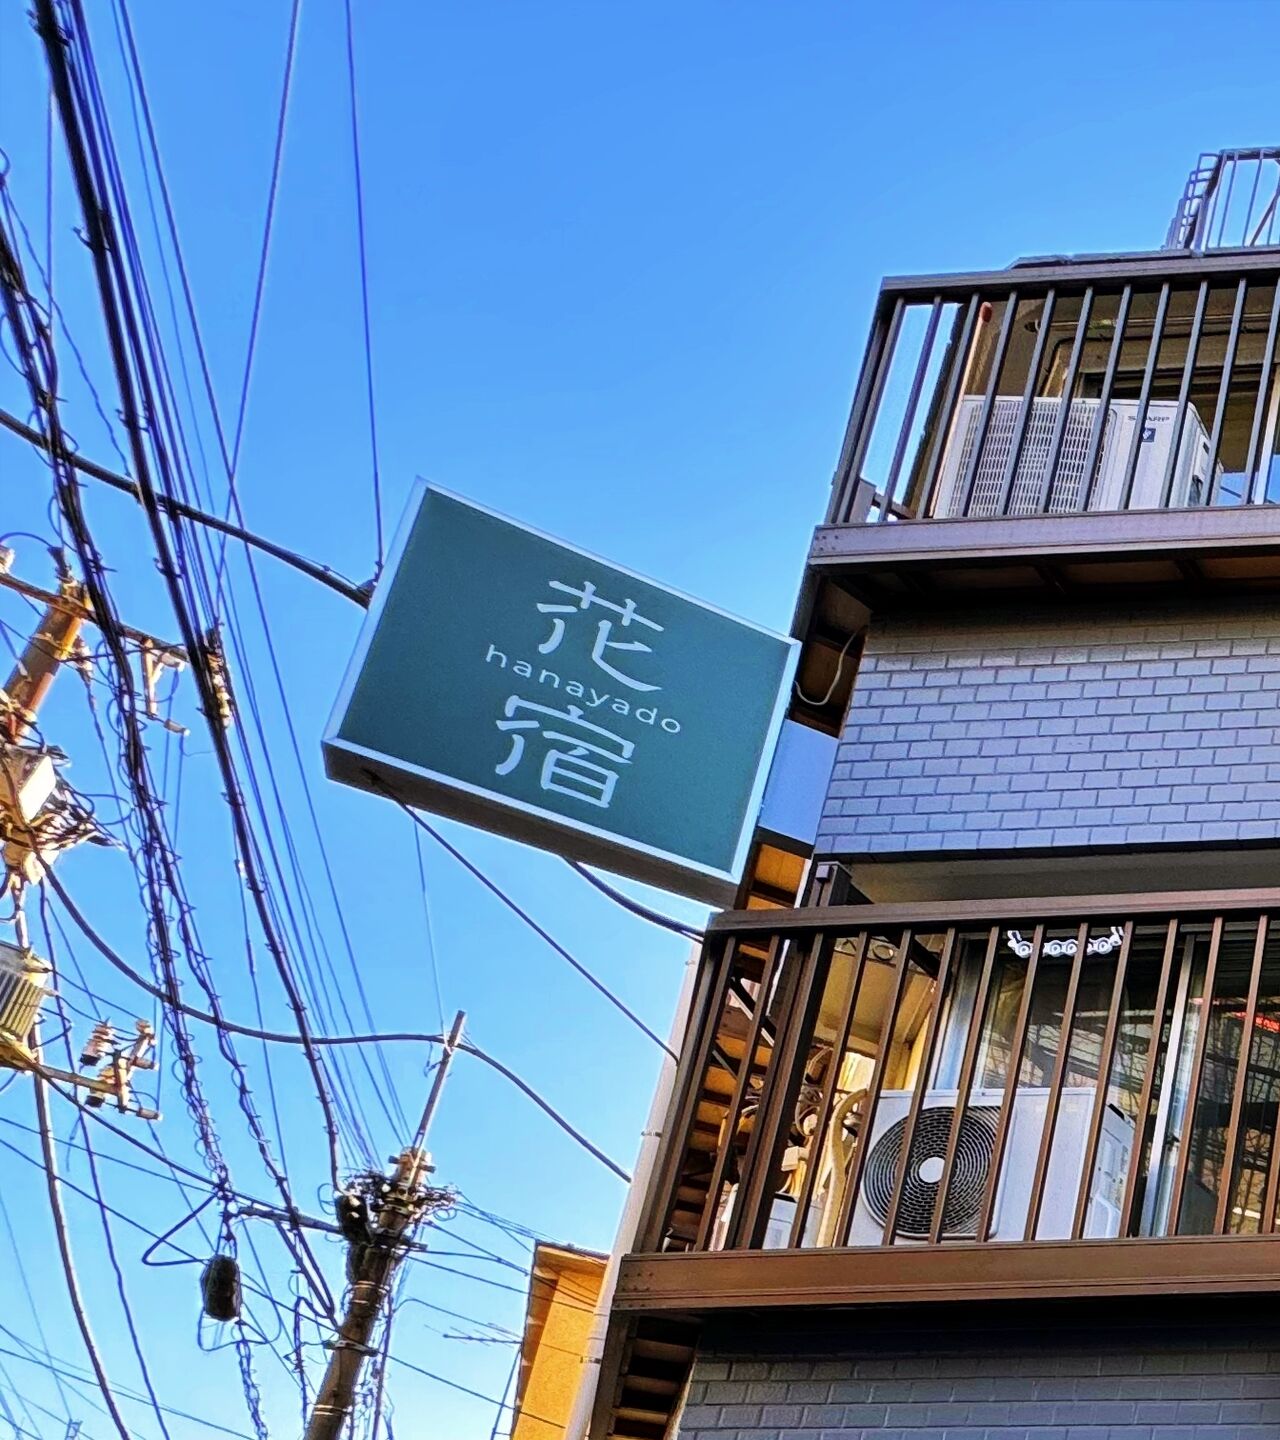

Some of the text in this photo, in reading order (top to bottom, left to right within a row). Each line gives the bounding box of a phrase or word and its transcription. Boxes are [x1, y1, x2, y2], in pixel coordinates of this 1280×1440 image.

[485, 644, 681, 734] hanayado
[536, 580, 665, 692] 花
[495, 695, 636, 808] 宿
